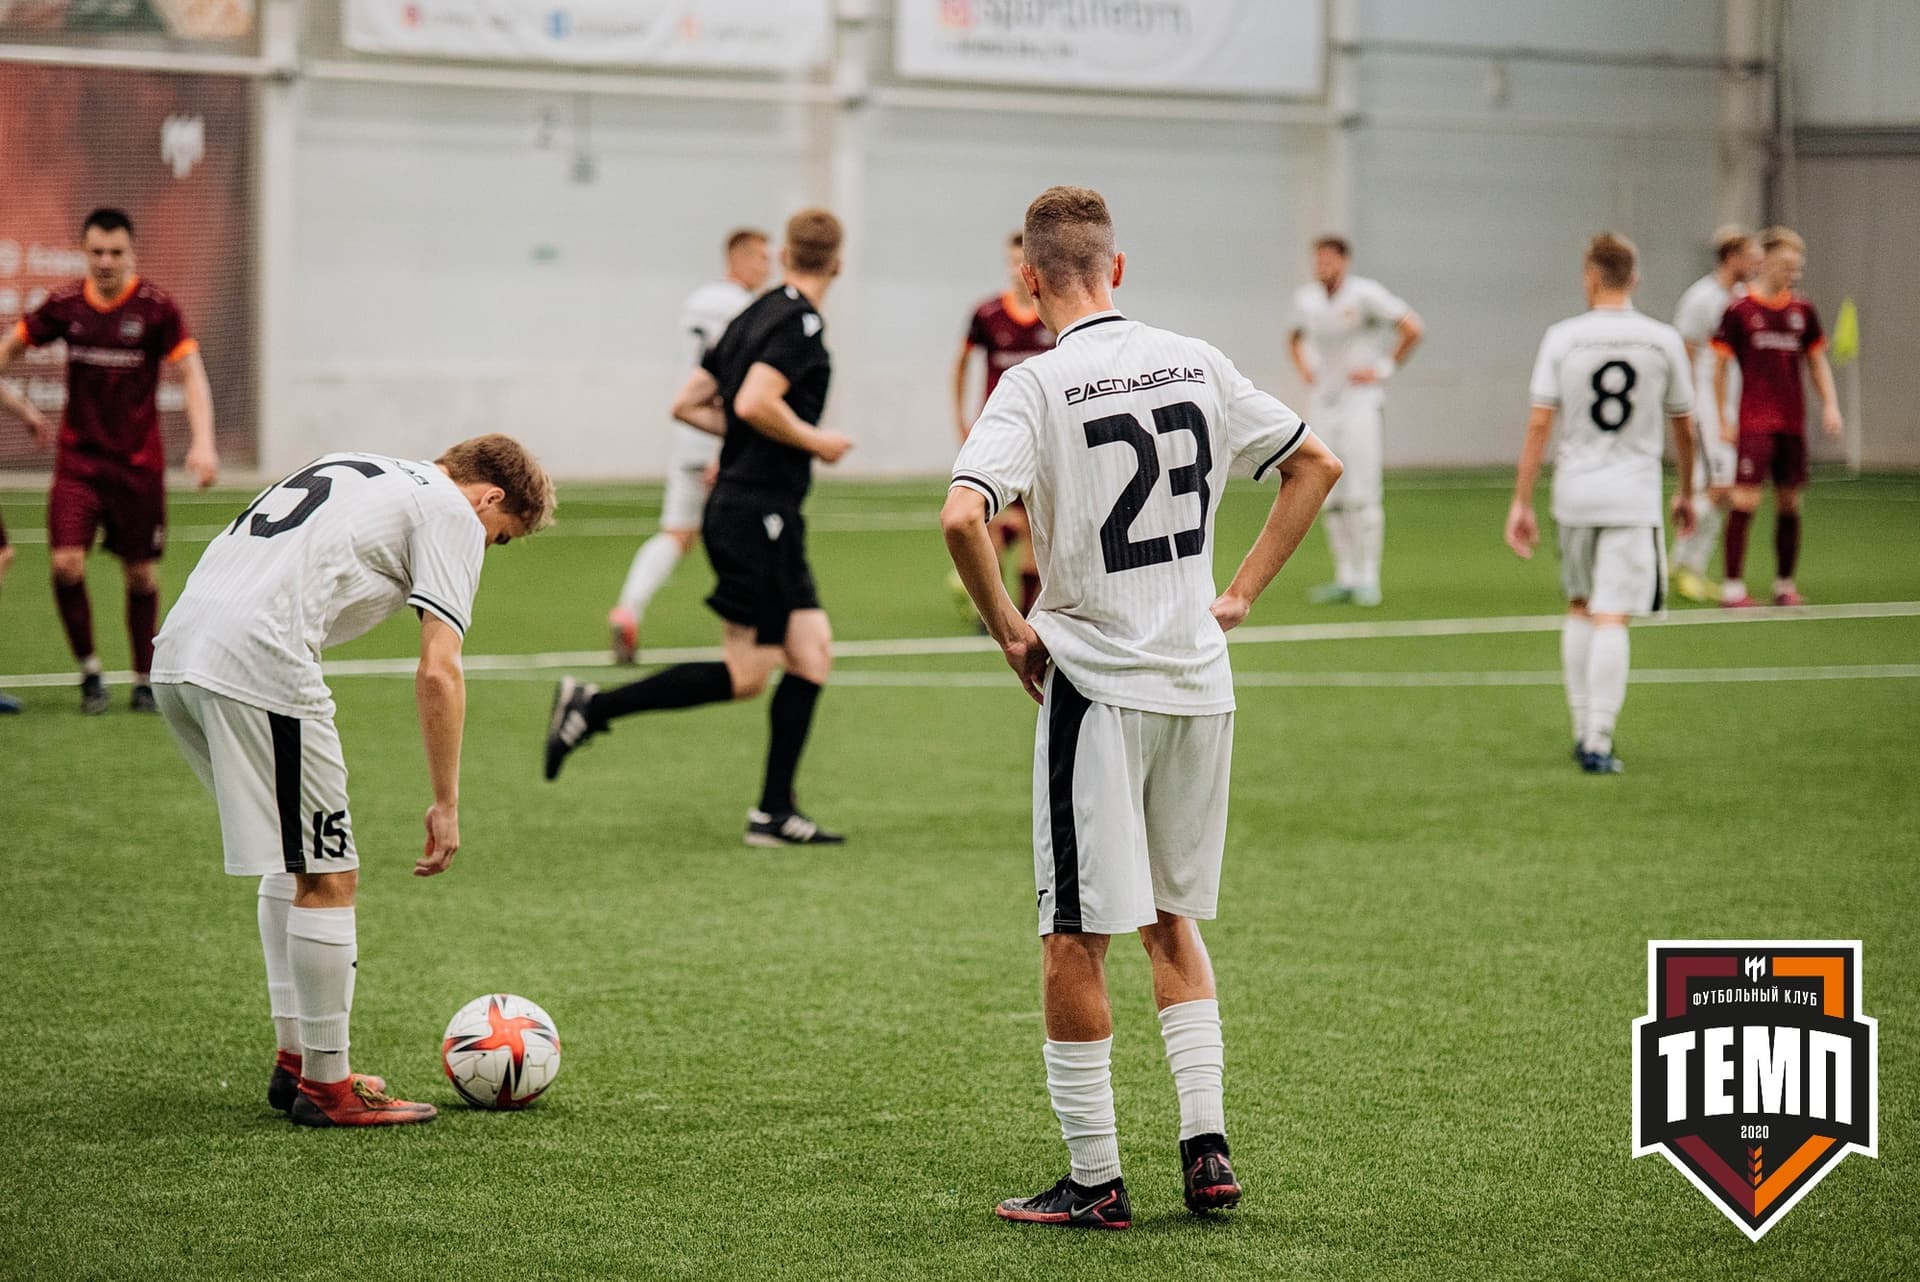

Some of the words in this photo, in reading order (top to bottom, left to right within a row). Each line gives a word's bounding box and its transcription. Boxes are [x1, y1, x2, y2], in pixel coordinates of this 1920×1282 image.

[1591, 360, 1636, 431] 8
[1083, 401, 1213, 574] 23
[312, 810, 347, 860] 15
